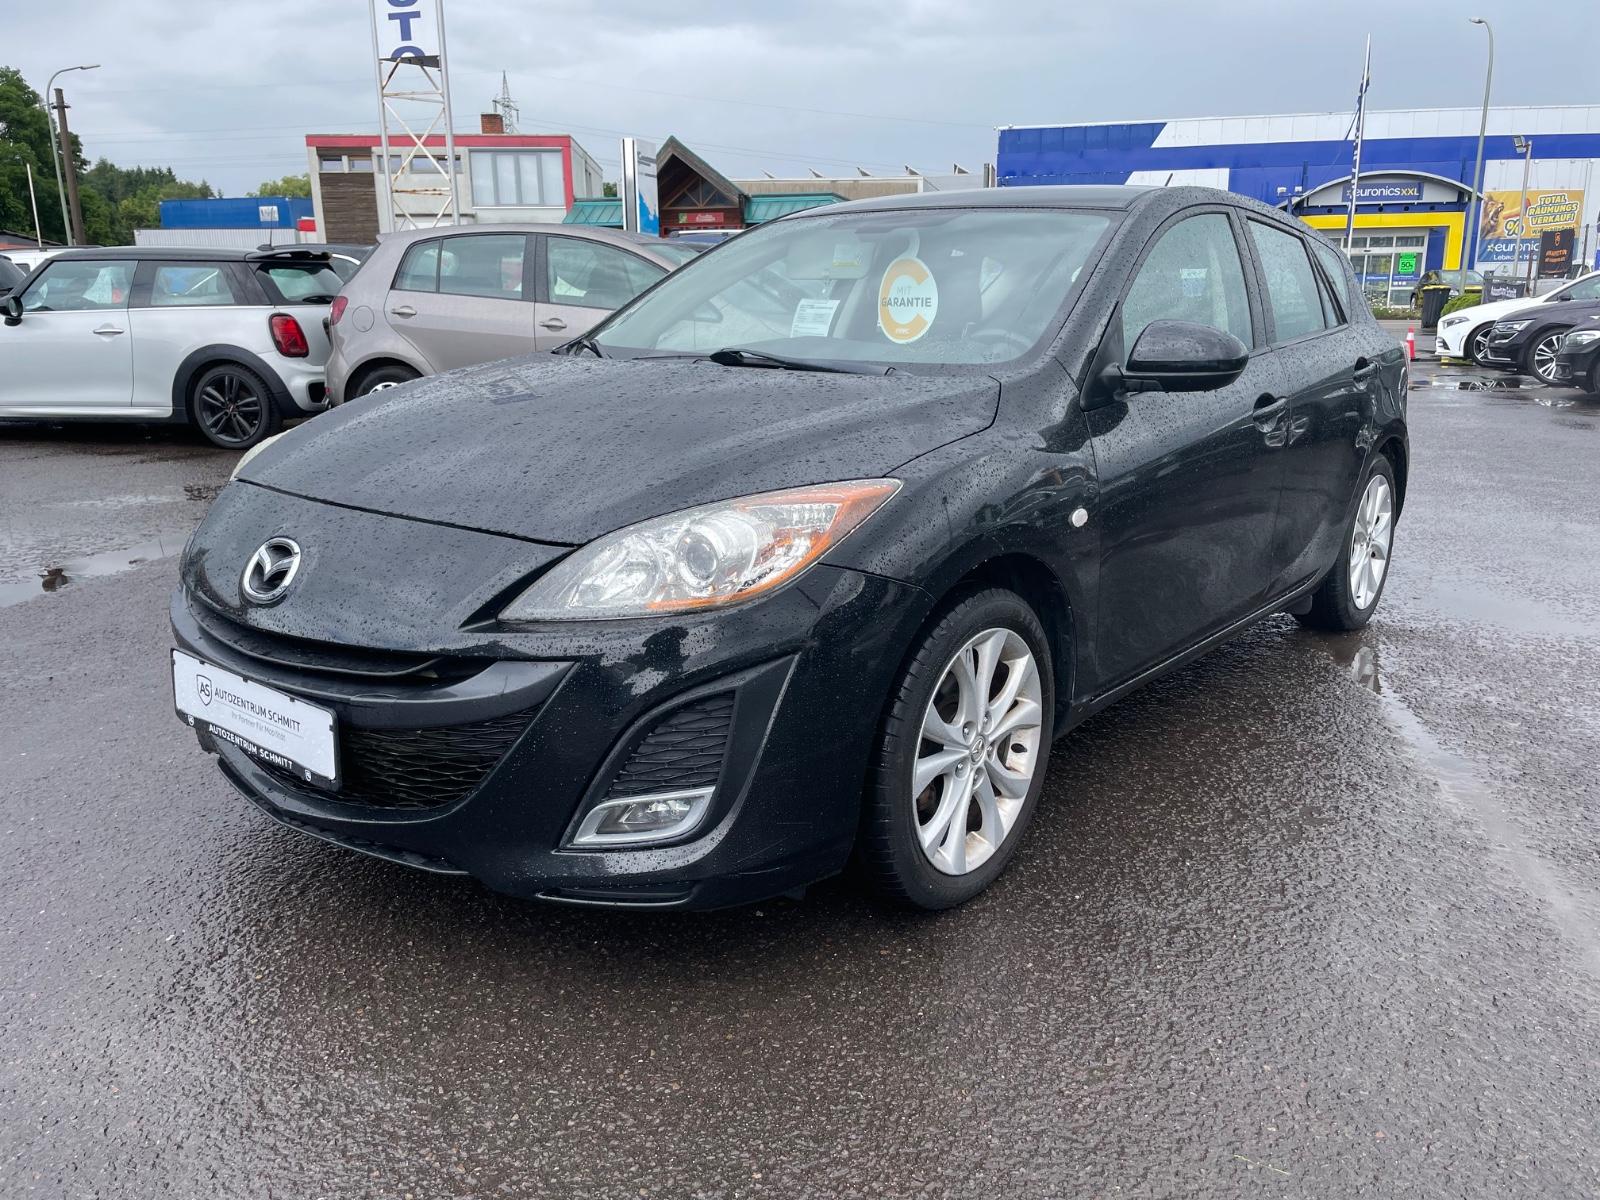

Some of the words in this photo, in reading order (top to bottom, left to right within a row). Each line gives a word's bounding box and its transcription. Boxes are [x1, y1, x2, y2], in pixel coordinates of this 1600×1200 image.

[1540, 194, 1566, 205] TOTAL
[1531, 212, 1575, 225] VERKAUF!
[1494, 240, 1540, 252] euronic
[896, 286, 913, 294] MIT
[881, 296, 932, 307] GARANTIE
[199, 682, 210, 698] AS
[214, 687, 267, 718] AUTOZENTRUM
[267, 710, 301, 733] SCHMITT
[208, 723, 258, 755] AUTOZENTRUM
[259, 748, 293, 770] SCHMITT
